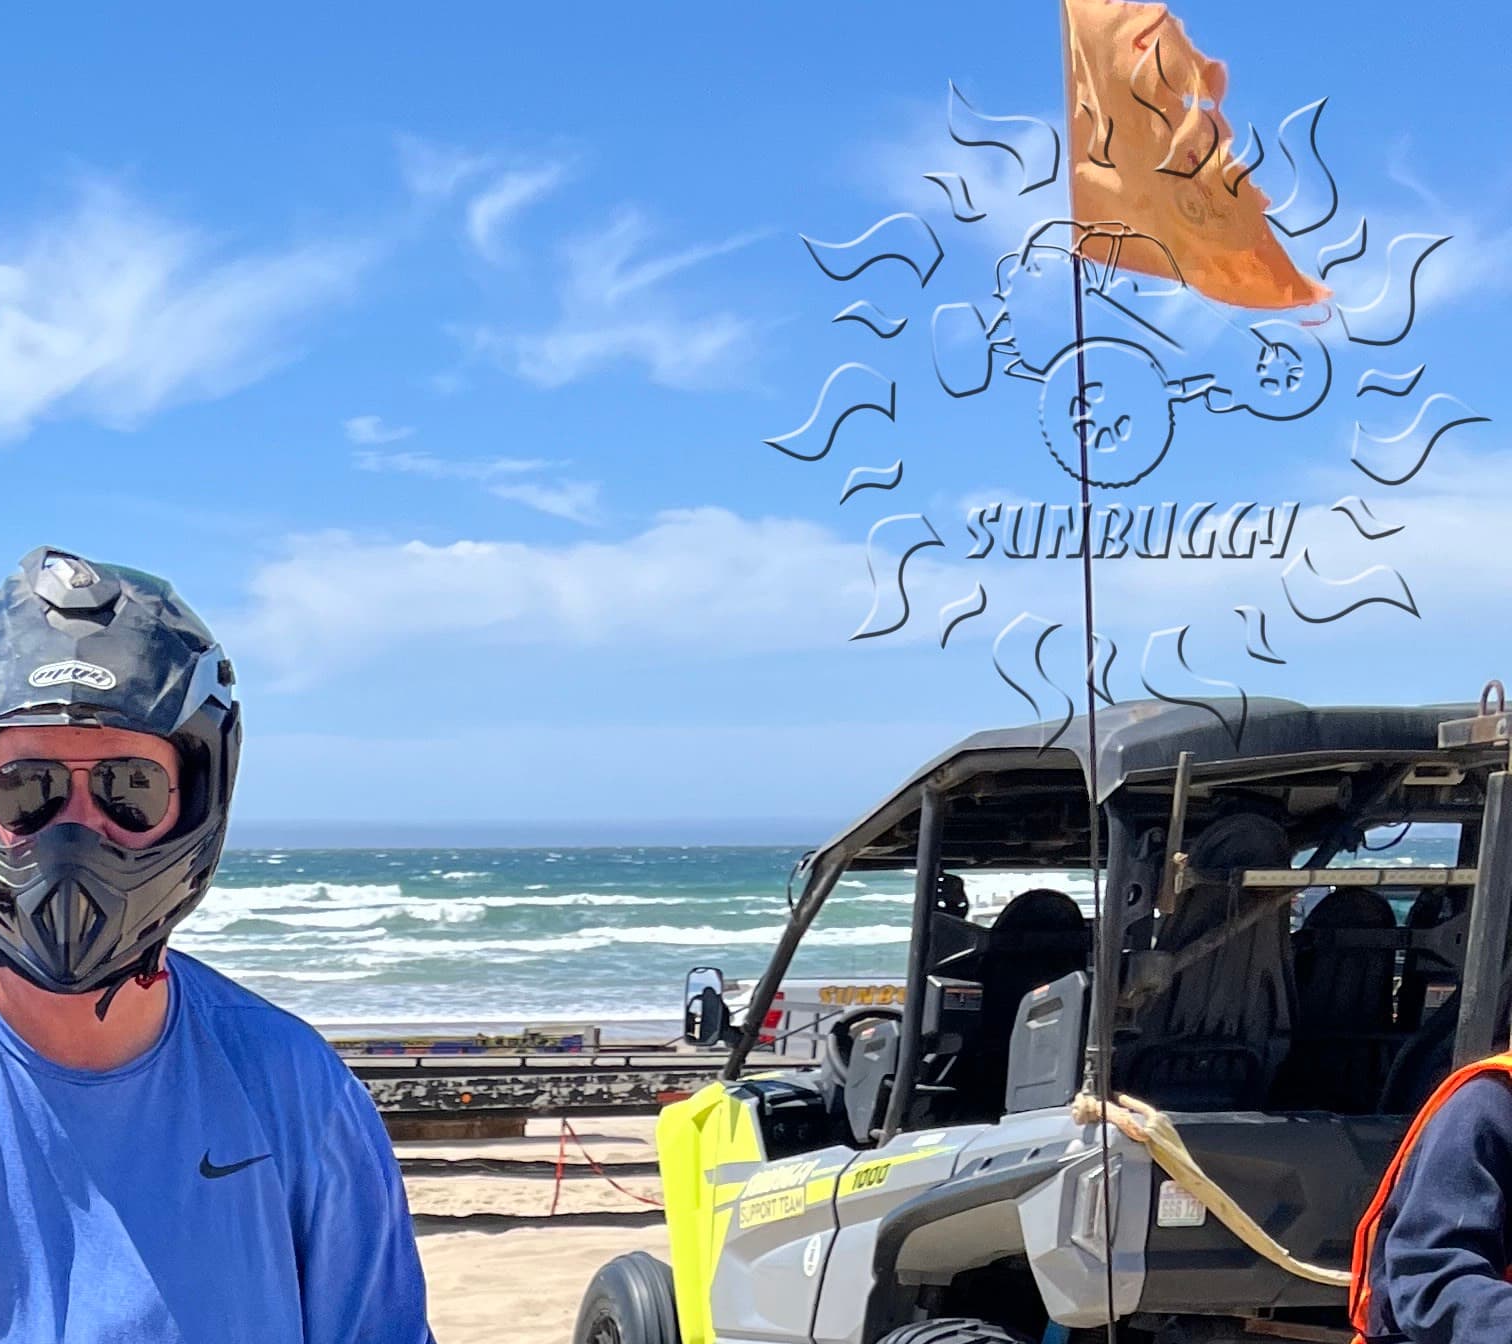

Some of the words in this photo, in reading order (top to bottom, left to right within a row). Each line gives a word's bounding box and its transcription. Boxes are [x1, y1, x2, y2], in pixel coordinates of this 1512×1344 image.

[852, 1164, 890, 1190] 1000
[740, 1197, 777, 1224] SUPPORT
[779, 1194, 804, 1214] TEAM
